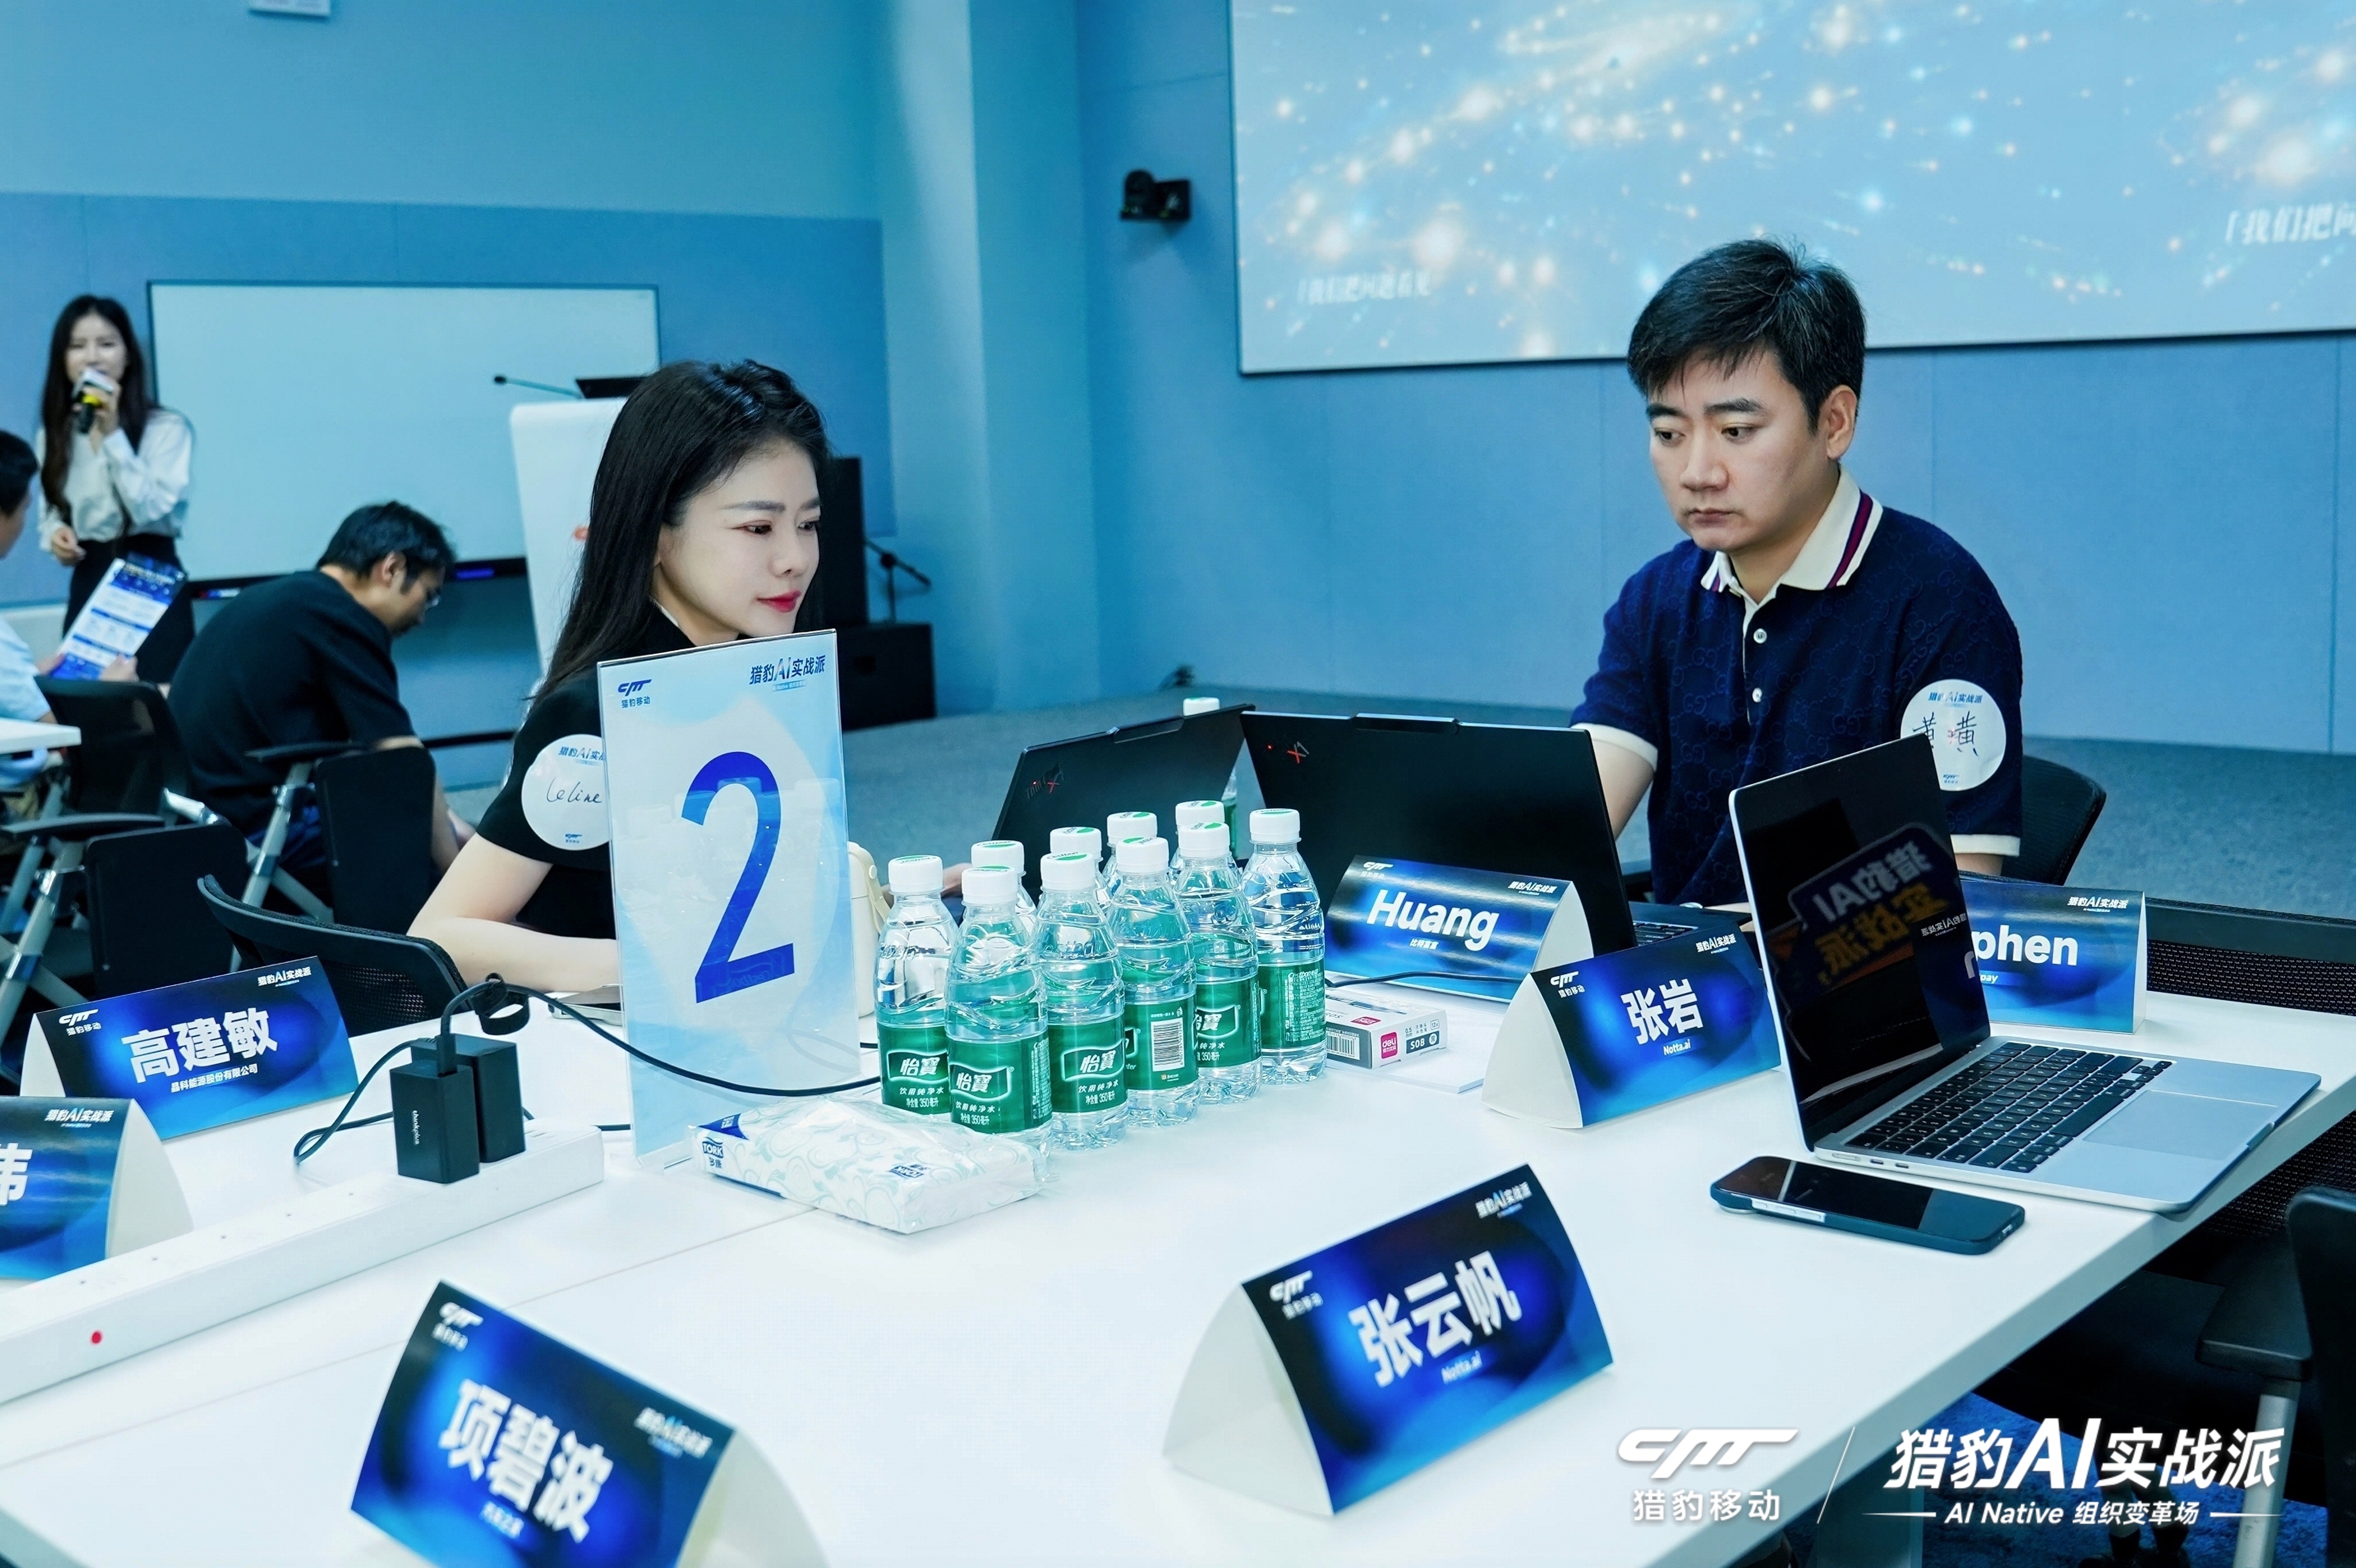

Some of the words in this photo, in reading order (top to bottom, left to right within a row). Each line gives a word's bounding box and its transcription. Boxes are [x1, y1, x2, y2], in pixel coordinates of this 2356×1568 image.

[621, 696, 651, 709] 猎豹移动
[681, 751, 795, 1004] 2
[1366, 889, 1500, 951] Huang
[1620, 978, 1703, 1045] 张岩
[121, 1007, 279, 1084] 高建敏
[1382, 1037, 1397, 1047] deli
[1410, 1037, 1425, 1050] S08
[1663, 1039, 1691, 1056] Notta.ai
[899, 1056, 940, 1077] 怡寶
[1080, 1050, 1116, 1074] 怡寶
[171, 1063, 258, 1093] 晶科能源股份有限公司
[956, 1072, 992, 1093] 怡寶
[1078, 1079, 1119, 1094] 饮用纯净水
[899, 1086, 944, 1096] 饮用纯净水
[955, 1101, 996, 1113] 饮用纯净水
[703, 1142, 723, 1158] TORK
[1348, 1250, 1523, 1388] 张云帆
[438, 1378, 615, 1543] 项碧波
